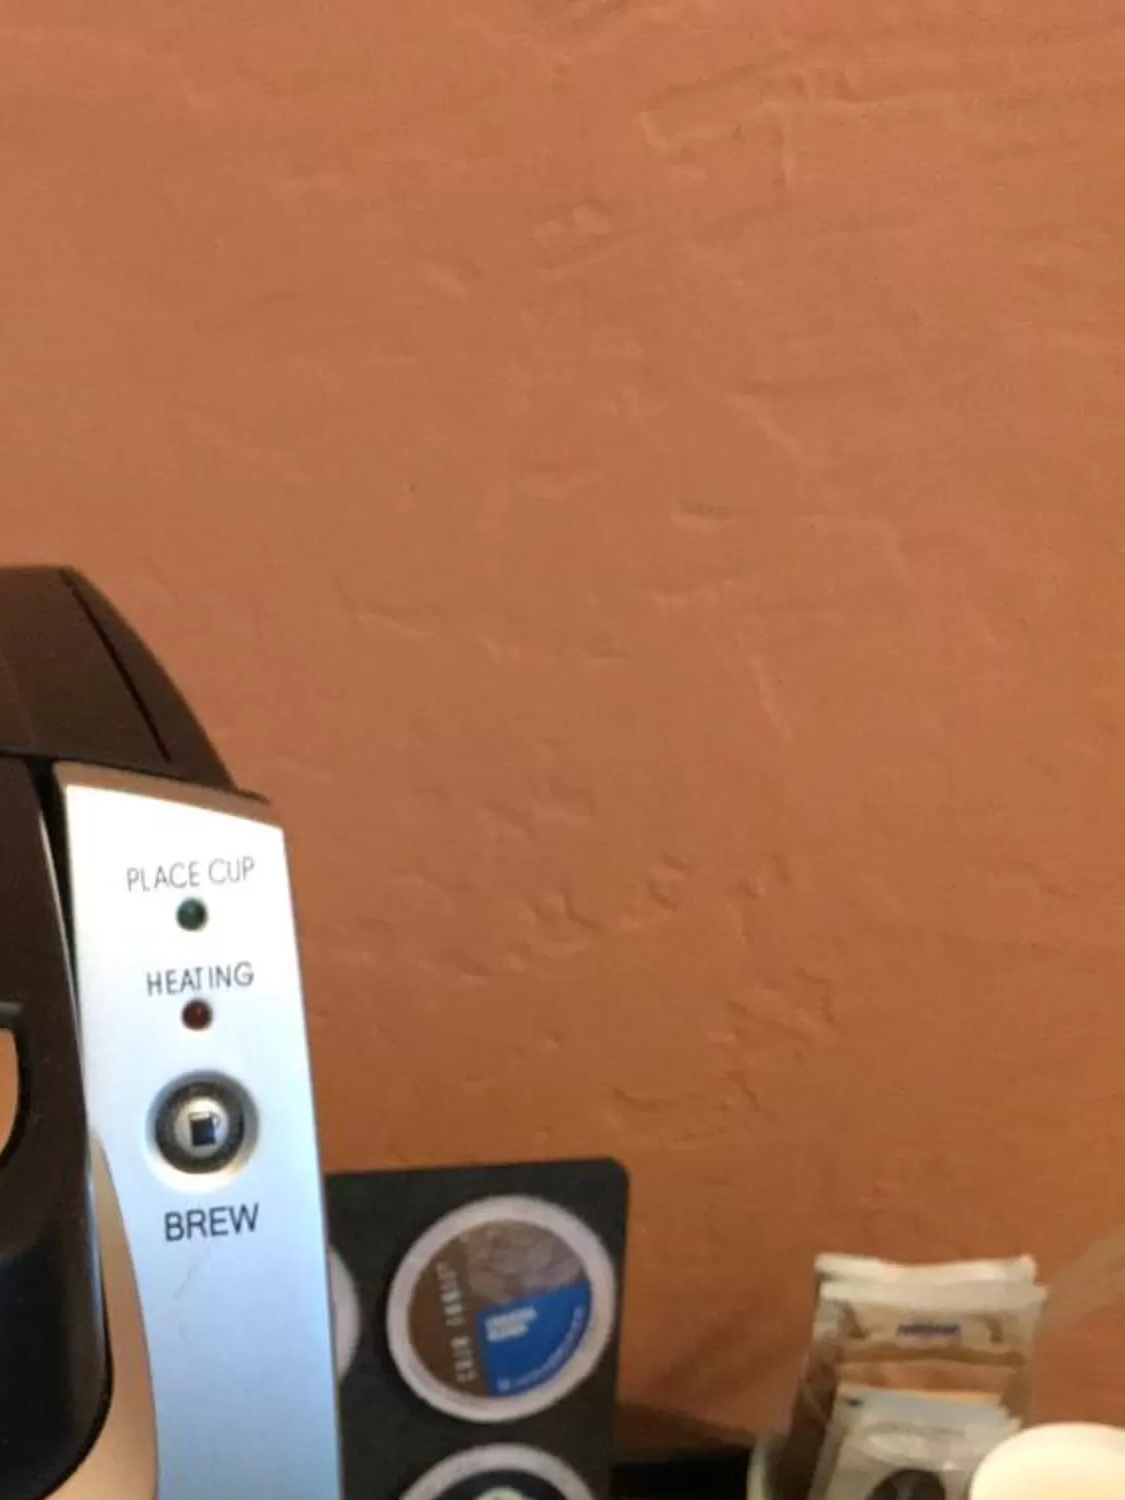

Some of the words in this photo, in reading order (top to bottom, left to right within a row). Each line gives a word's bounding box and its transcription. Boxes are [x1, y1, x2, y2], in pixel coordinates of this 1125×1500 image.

[125, 860, 201, 892] PLACE
[208, 856, 256, 885] CUP
[146, 961, 255, 997] HEATING
[164, 1203, 260, 1243] BREW
